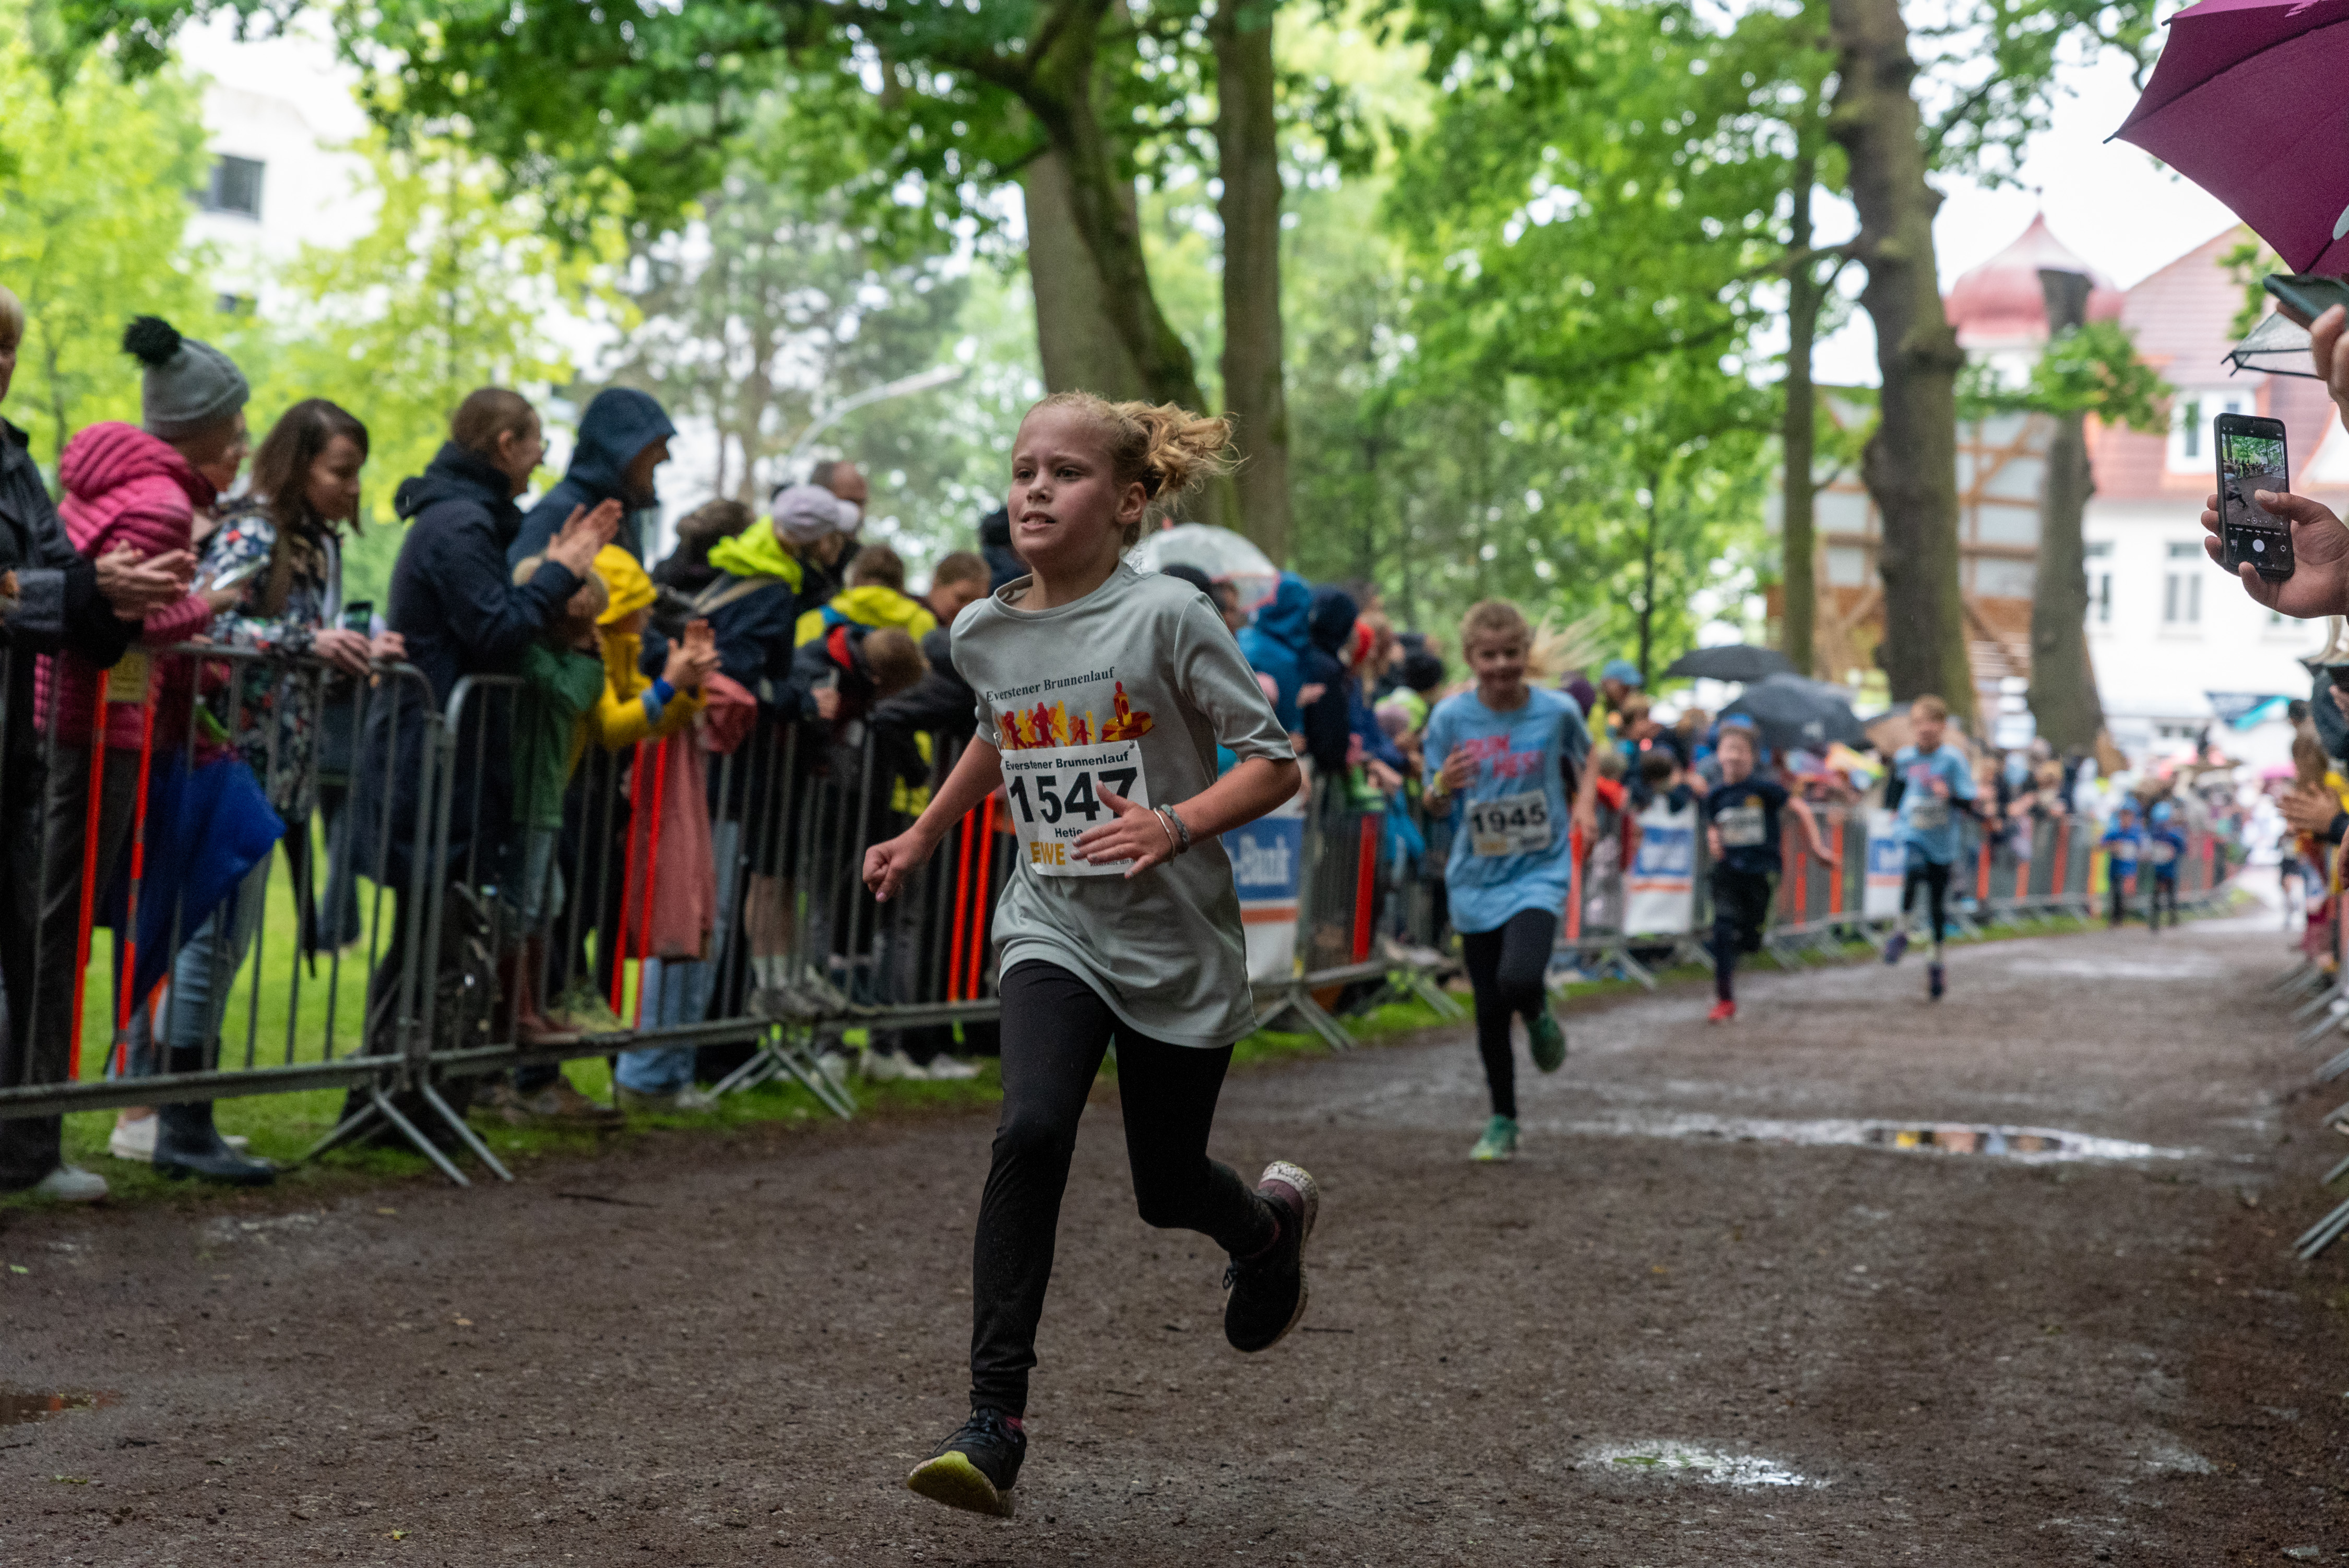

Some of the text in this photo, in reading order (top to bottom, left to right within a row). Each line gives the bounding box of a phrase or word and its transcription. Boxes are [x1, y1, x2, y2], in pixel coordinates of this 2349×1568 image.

[986, 666, 1115, 702] Everstener Brunnenlauf
[1005, 751, 1129, 770] Everstener Brunnenlauf
[1009, 766, 1138, 824] 1547
[1472, 803, 1547, 834] 1945
[1029, 841, 1066, 865] EWE
